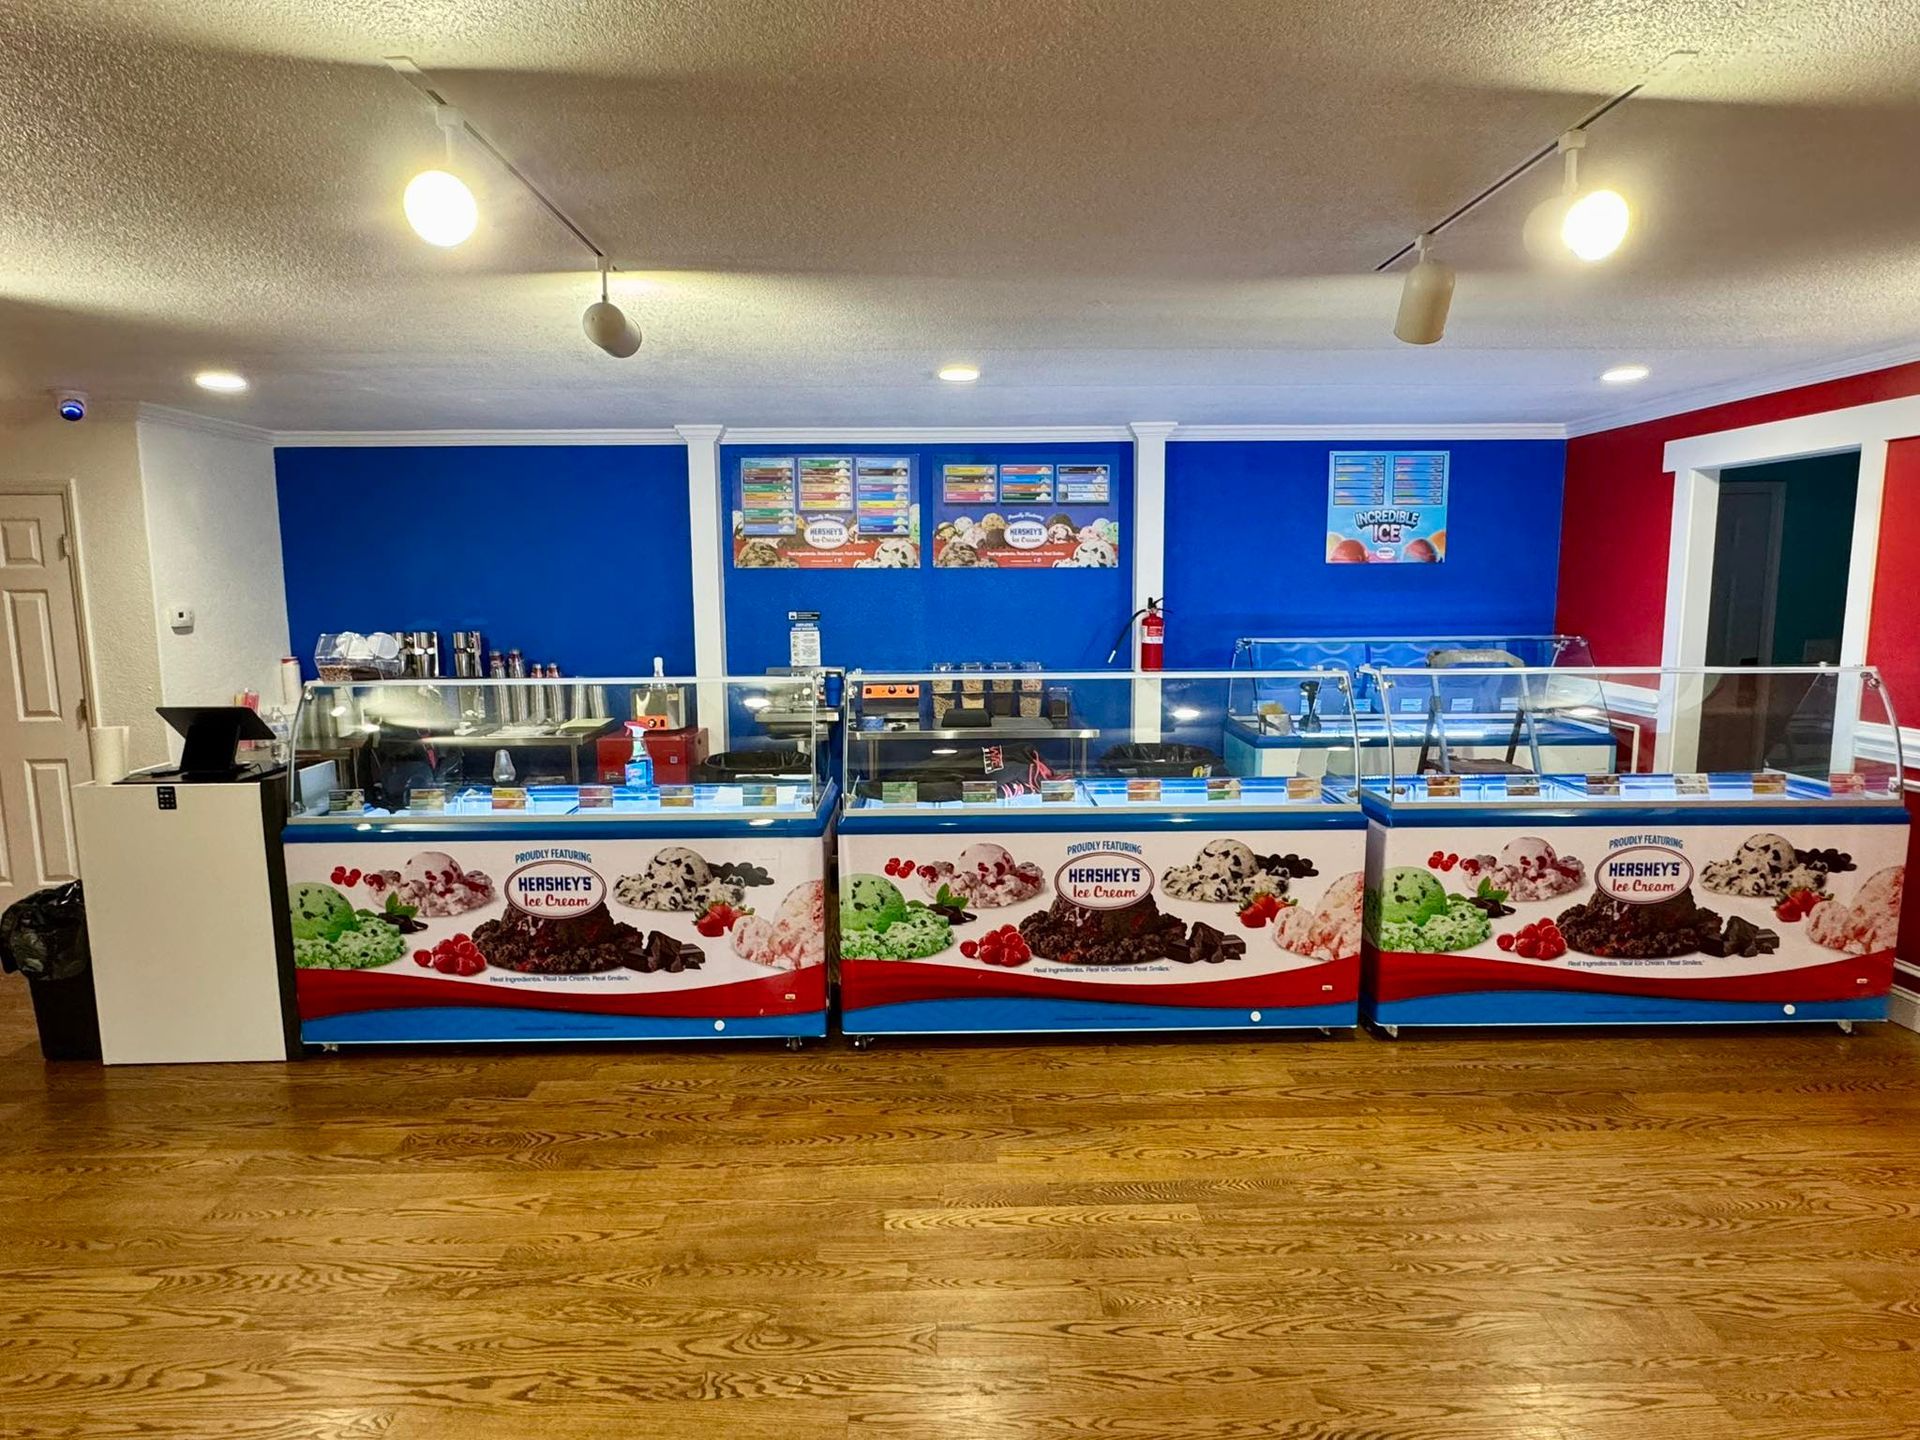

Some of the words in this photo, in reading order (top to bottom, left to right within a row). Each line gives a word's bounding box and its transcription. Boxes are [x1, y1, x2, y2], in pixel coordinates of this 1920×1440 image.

[1355, 510, 1419, 526] INCREDIBLE
[1373, 524, 1401, 543] ICE
[1067, 841, 1100, 855] PROUDLY
[1102, 841, 1142, 854] FEATURING
[1609, 835, 1643, 850] PROUDLY
[1644, 835, 1684, 849] FEATURING
[515, 849, 549, 864] PROUDLY
[551, 848, 592, 863] FEATURING
[1069, 868, 1140, 883] HERSHEY'S
[1609, 862, 1680, 877] HERSHEY'S
[518, 876, 592, 891] HERSHEY'S
[1073, 884, 1091, 898] Ice
[1094, 885, 1137, 898] Cream
[1612, 879, 1630, 892] Ice
[1632, 879, 1675, 892] Cream
[524, 893, 542, 906] Ice
[545, 894, 590, 906] Cream
